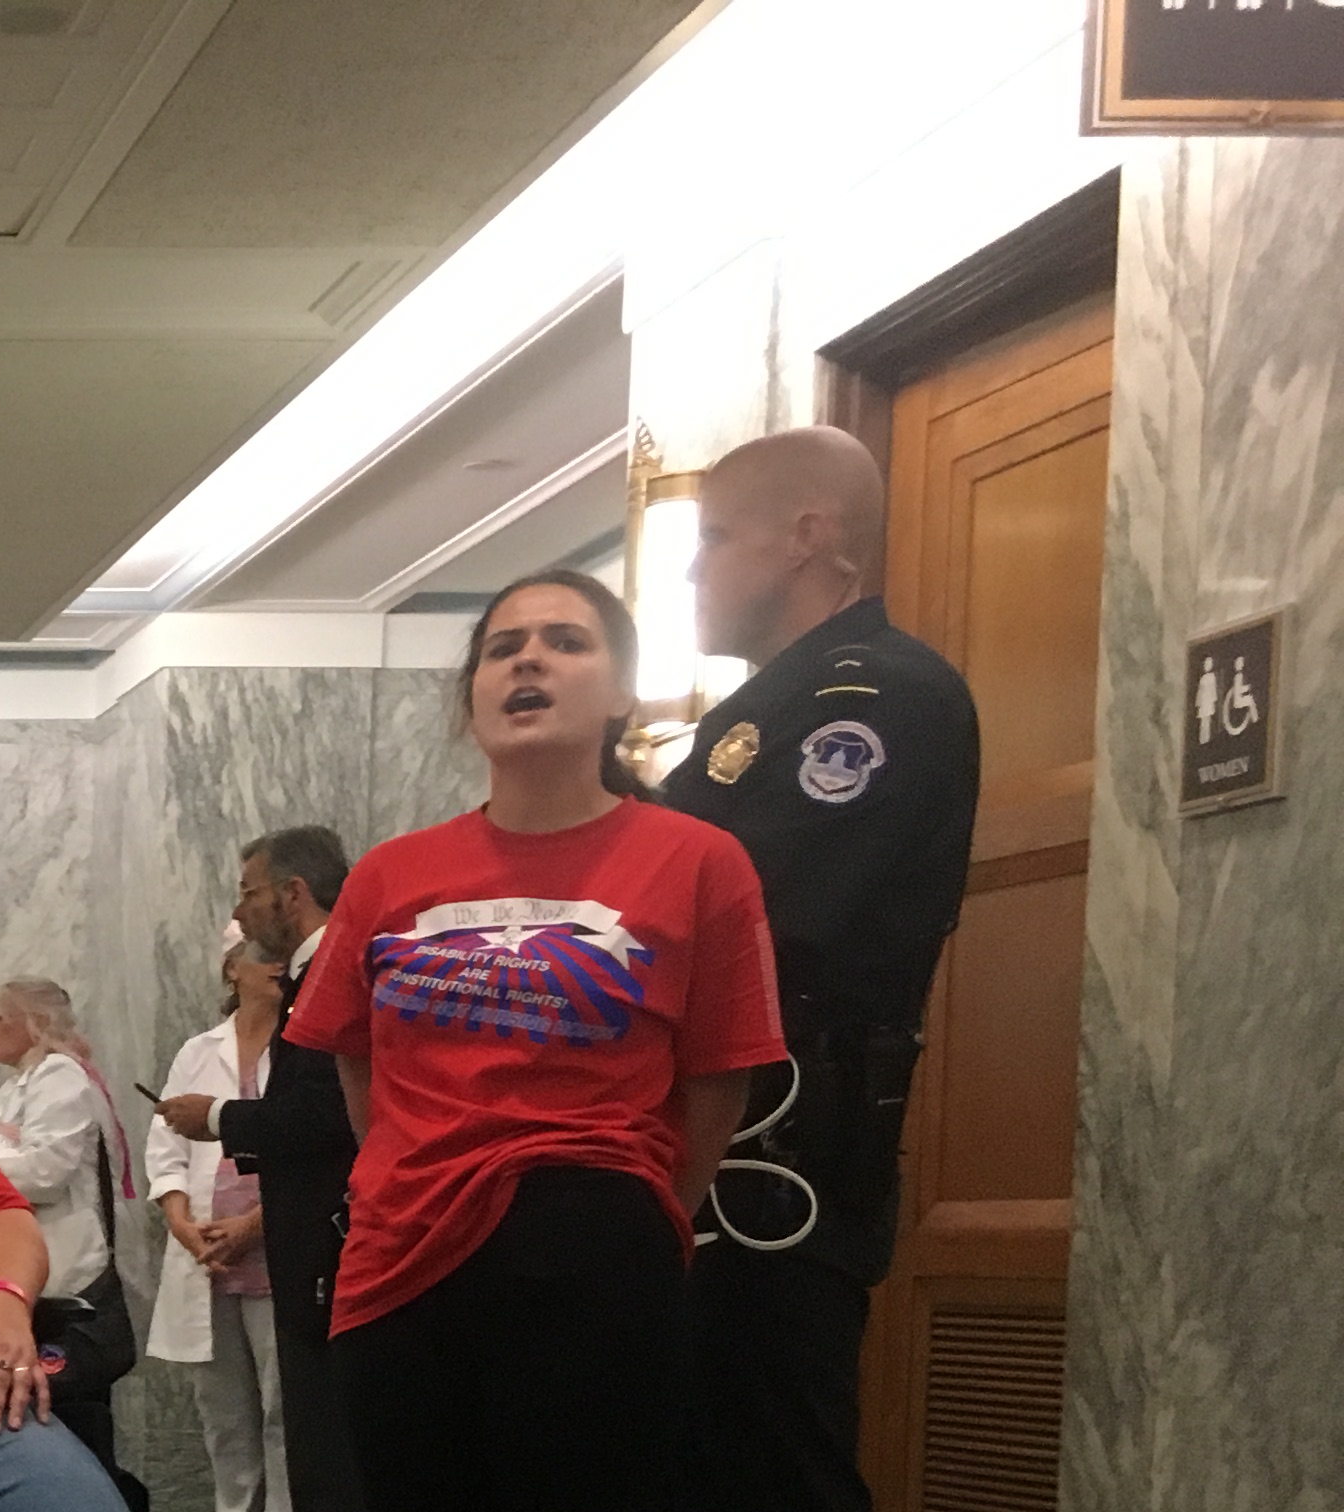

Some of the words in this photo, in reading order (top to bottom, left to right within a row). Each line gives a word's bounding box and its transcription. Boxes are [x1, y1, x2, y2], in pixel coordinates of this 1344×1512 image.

[1197, 756, 1250, 784] WOMEN
[413, 945, 493, 964] DISABILITY
[492, 954, 552, 972] RIGHTS
[458, 966, 492, 981] ARE
